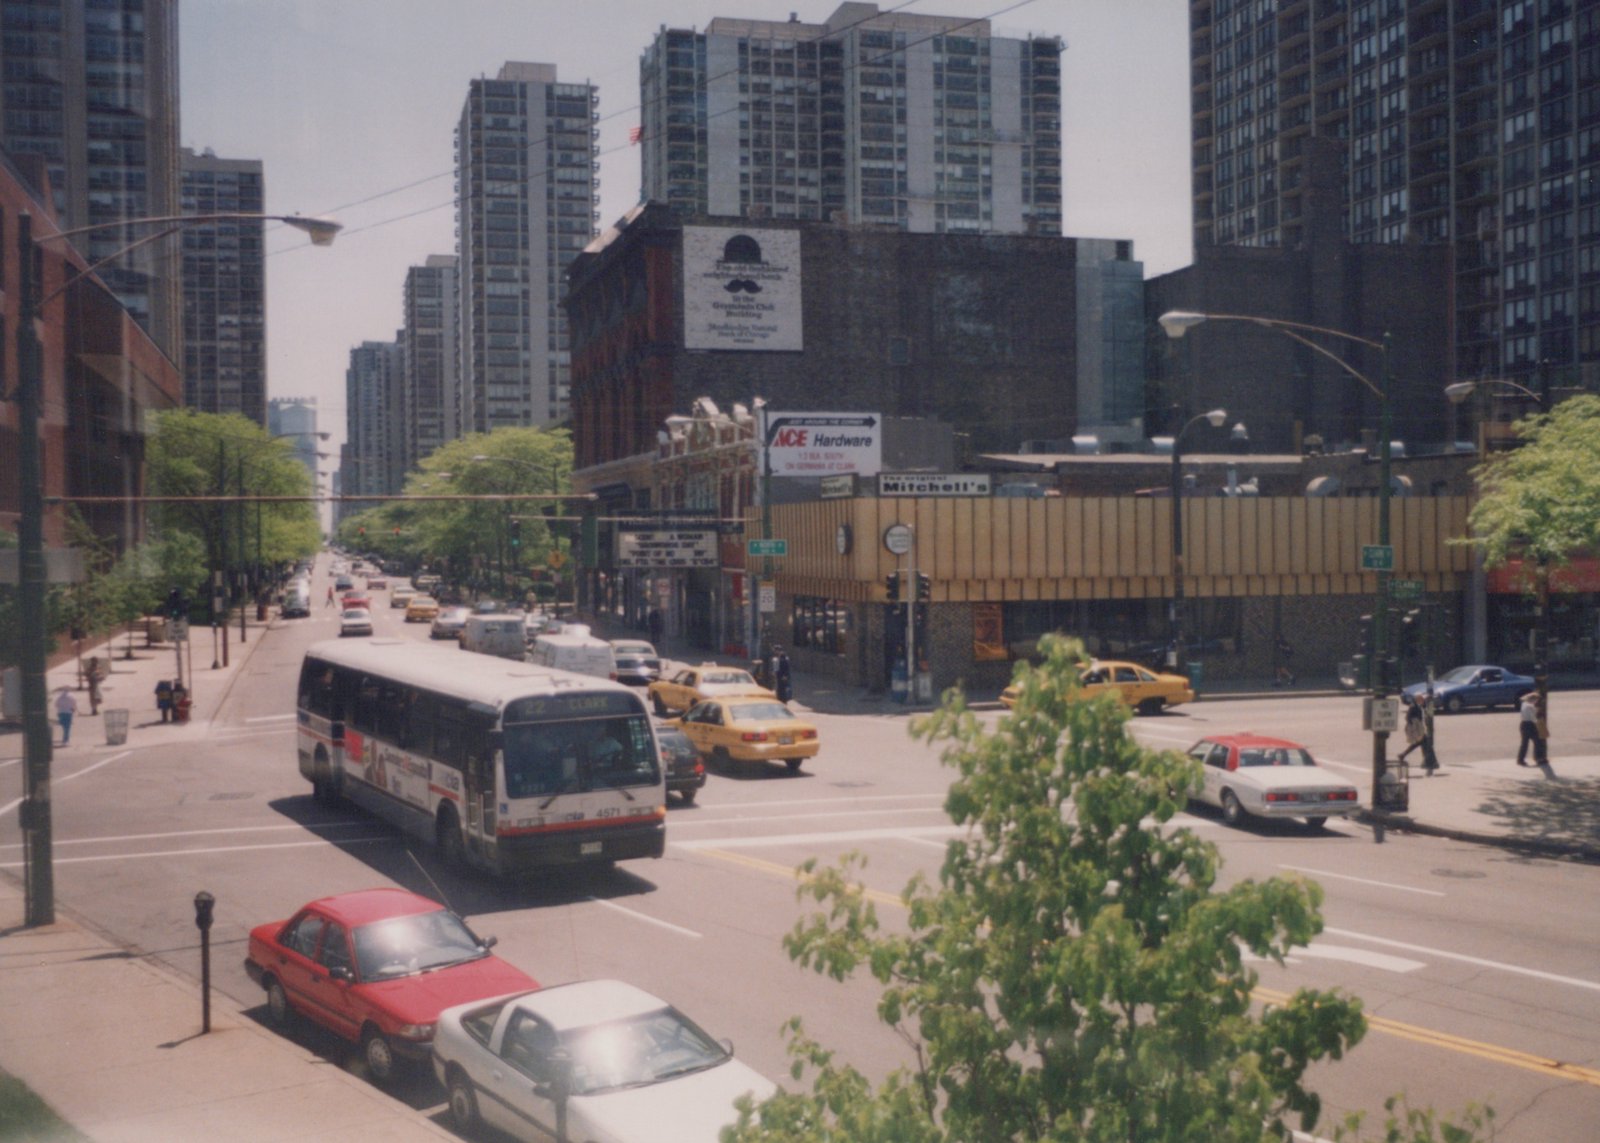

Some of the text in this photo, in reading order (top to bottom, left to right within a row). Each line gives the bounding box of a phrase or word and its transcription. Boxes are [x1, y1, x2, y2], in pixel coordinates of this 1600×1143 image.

[773, 428, 873, 447] ACE Hardware
[883, 482, 988, 493] Mitchell's
[596, 808, 621, 818] 4571
